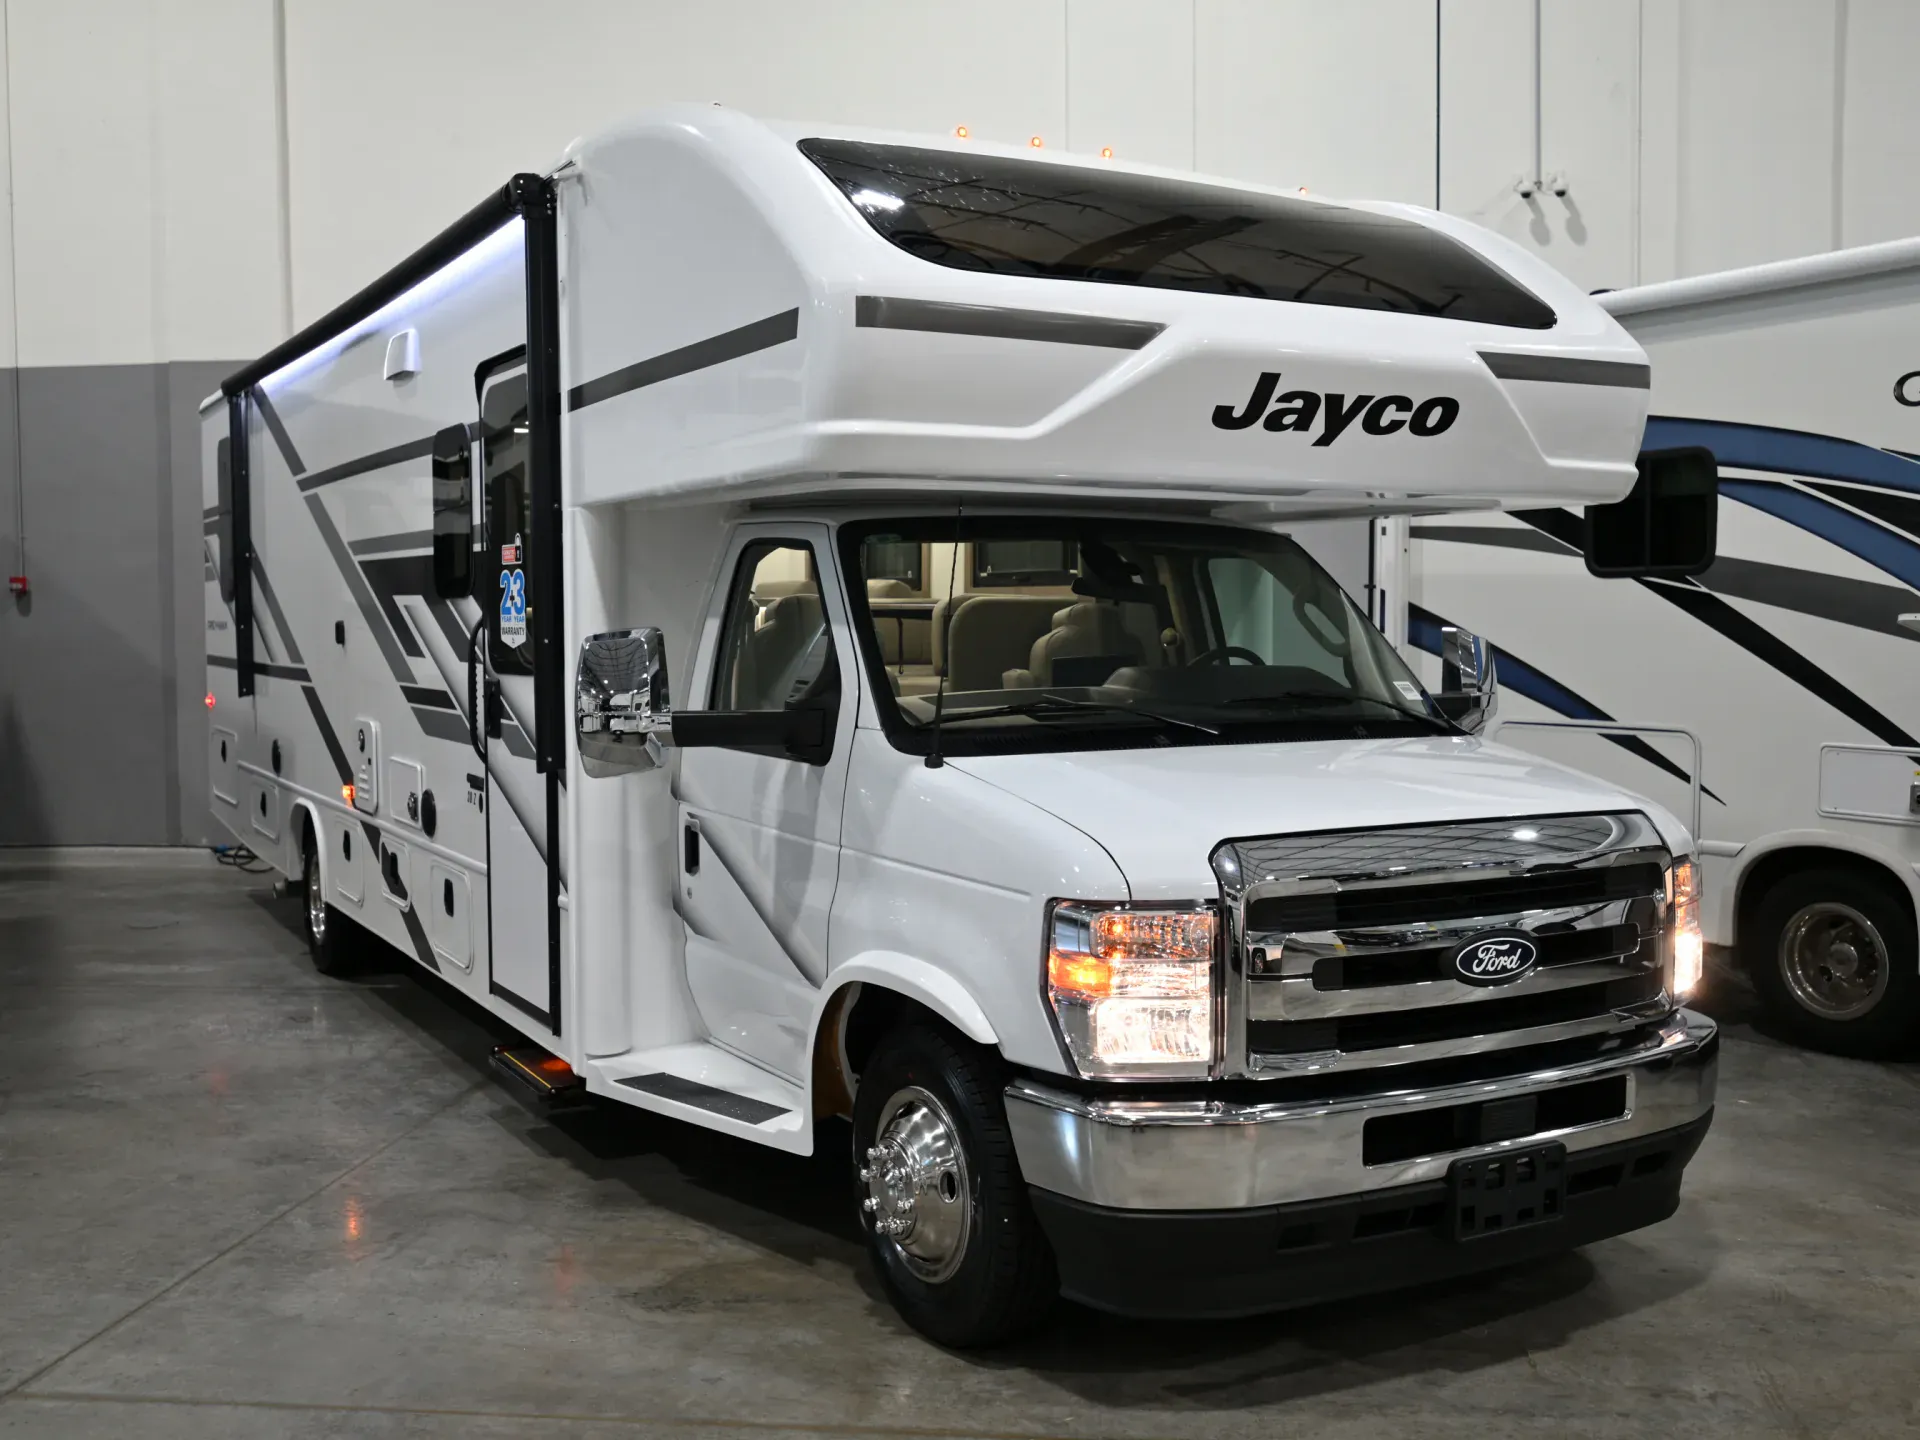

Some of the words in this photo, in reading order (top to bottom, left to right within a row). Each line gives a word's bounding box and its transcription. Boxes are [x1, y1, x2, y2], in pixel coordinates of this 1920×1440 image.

[1211, 371, 1460, 447] Jayco
[501, 626, 525, 636] WARRANTY
[1472, 943, 1522, 973] Ford
